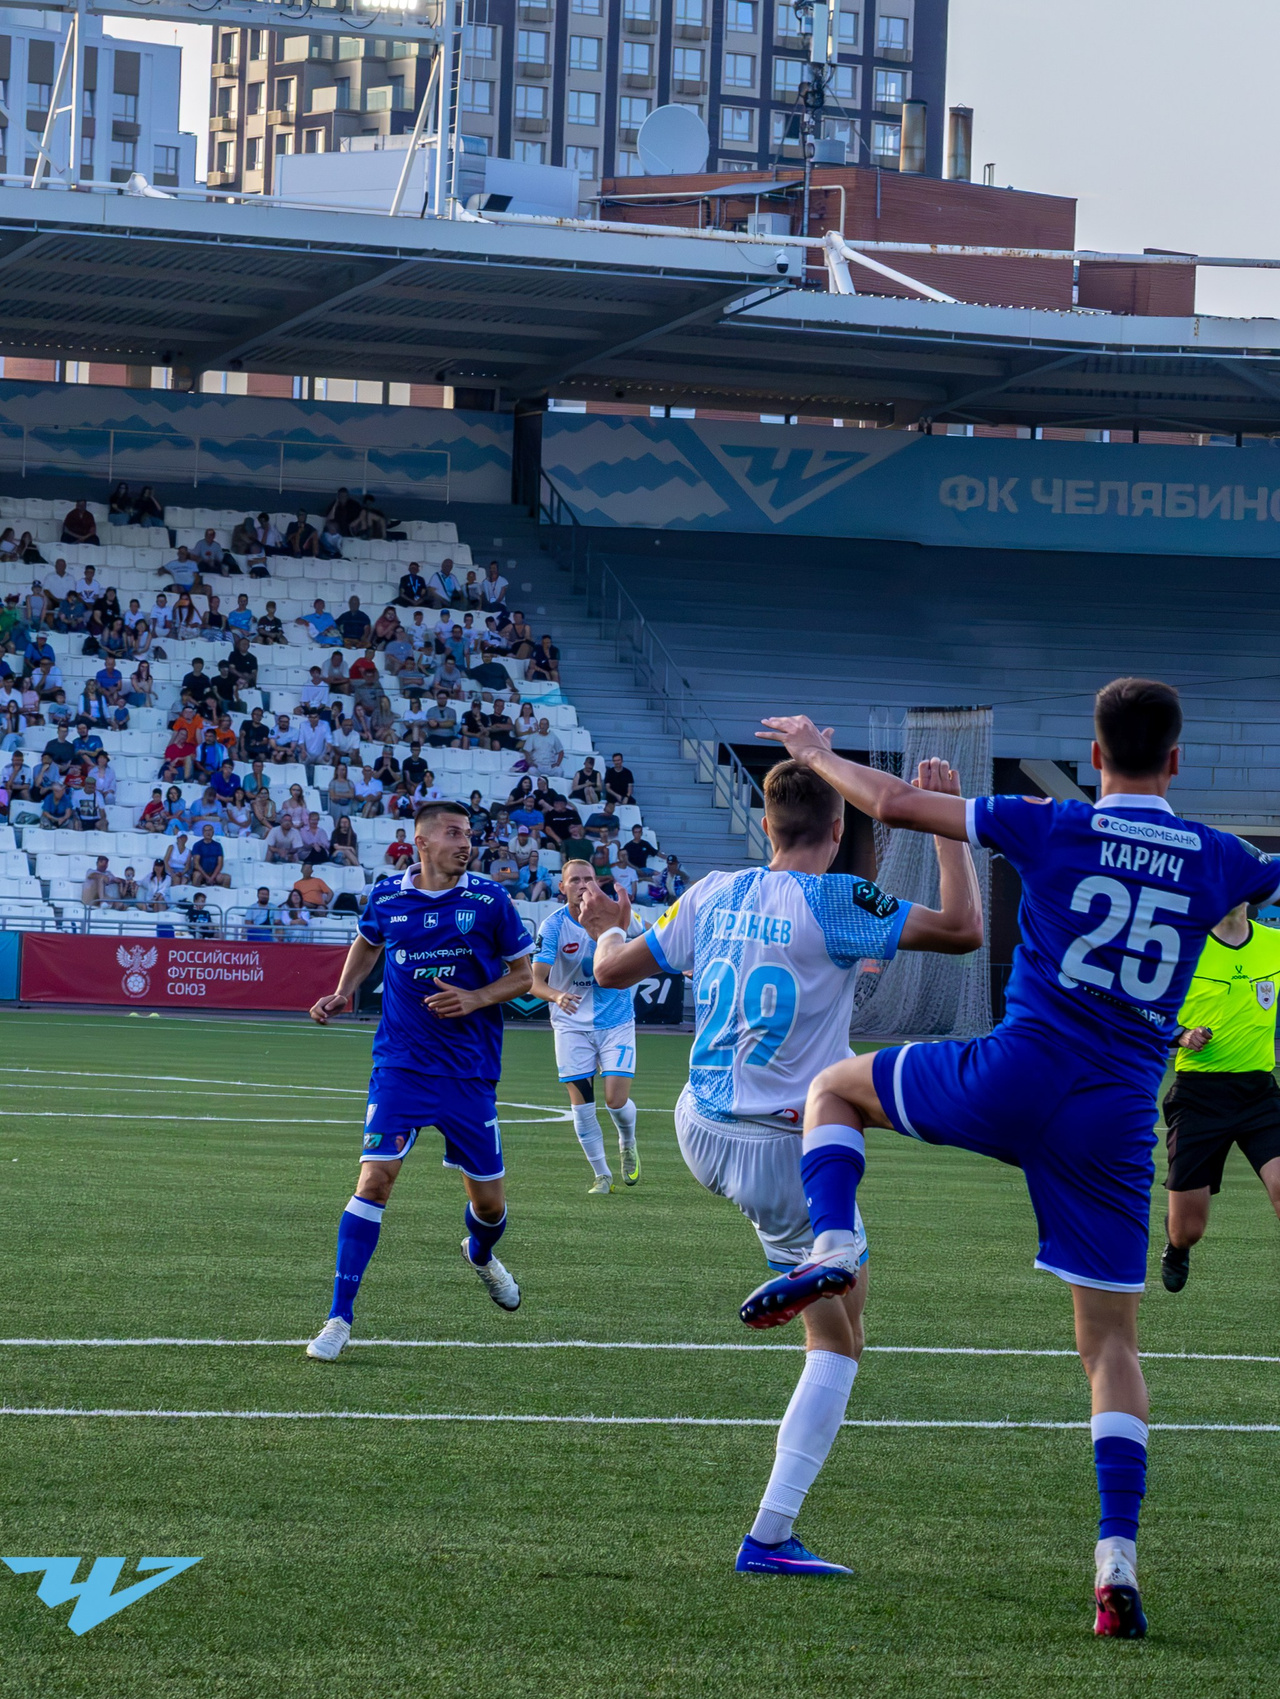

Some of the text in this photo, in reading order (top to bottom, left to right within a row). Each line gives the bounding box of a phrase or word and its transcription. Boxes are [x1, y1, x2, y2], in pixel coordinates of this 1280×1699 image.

[938, 474, 1019, 514] ФК
[1110, 821, 1197, 847] СОВКОМБАНК
[1100, 841, 1185, 882] КАРИЧ
[460, 890, 495, 904] PARI
[390, 915, 408, 923] JAKO
[1061, 875, 1191, 1001] 25
[168, 949, 260, 966] РОССИЙСКИЙ
[408, 948, 473, 961] НИЖФАРМ
[167, 966, 264, 982] ФУТБОЛЬНЫЙ
[413, 965, 456, 980] PARI
[167, 982, 207, 996] СОЮЗ
[634, 977, 672, 1004] RI
[689, 958, 799, 1071] 29
[616, 1045, 634, 1069] 77
